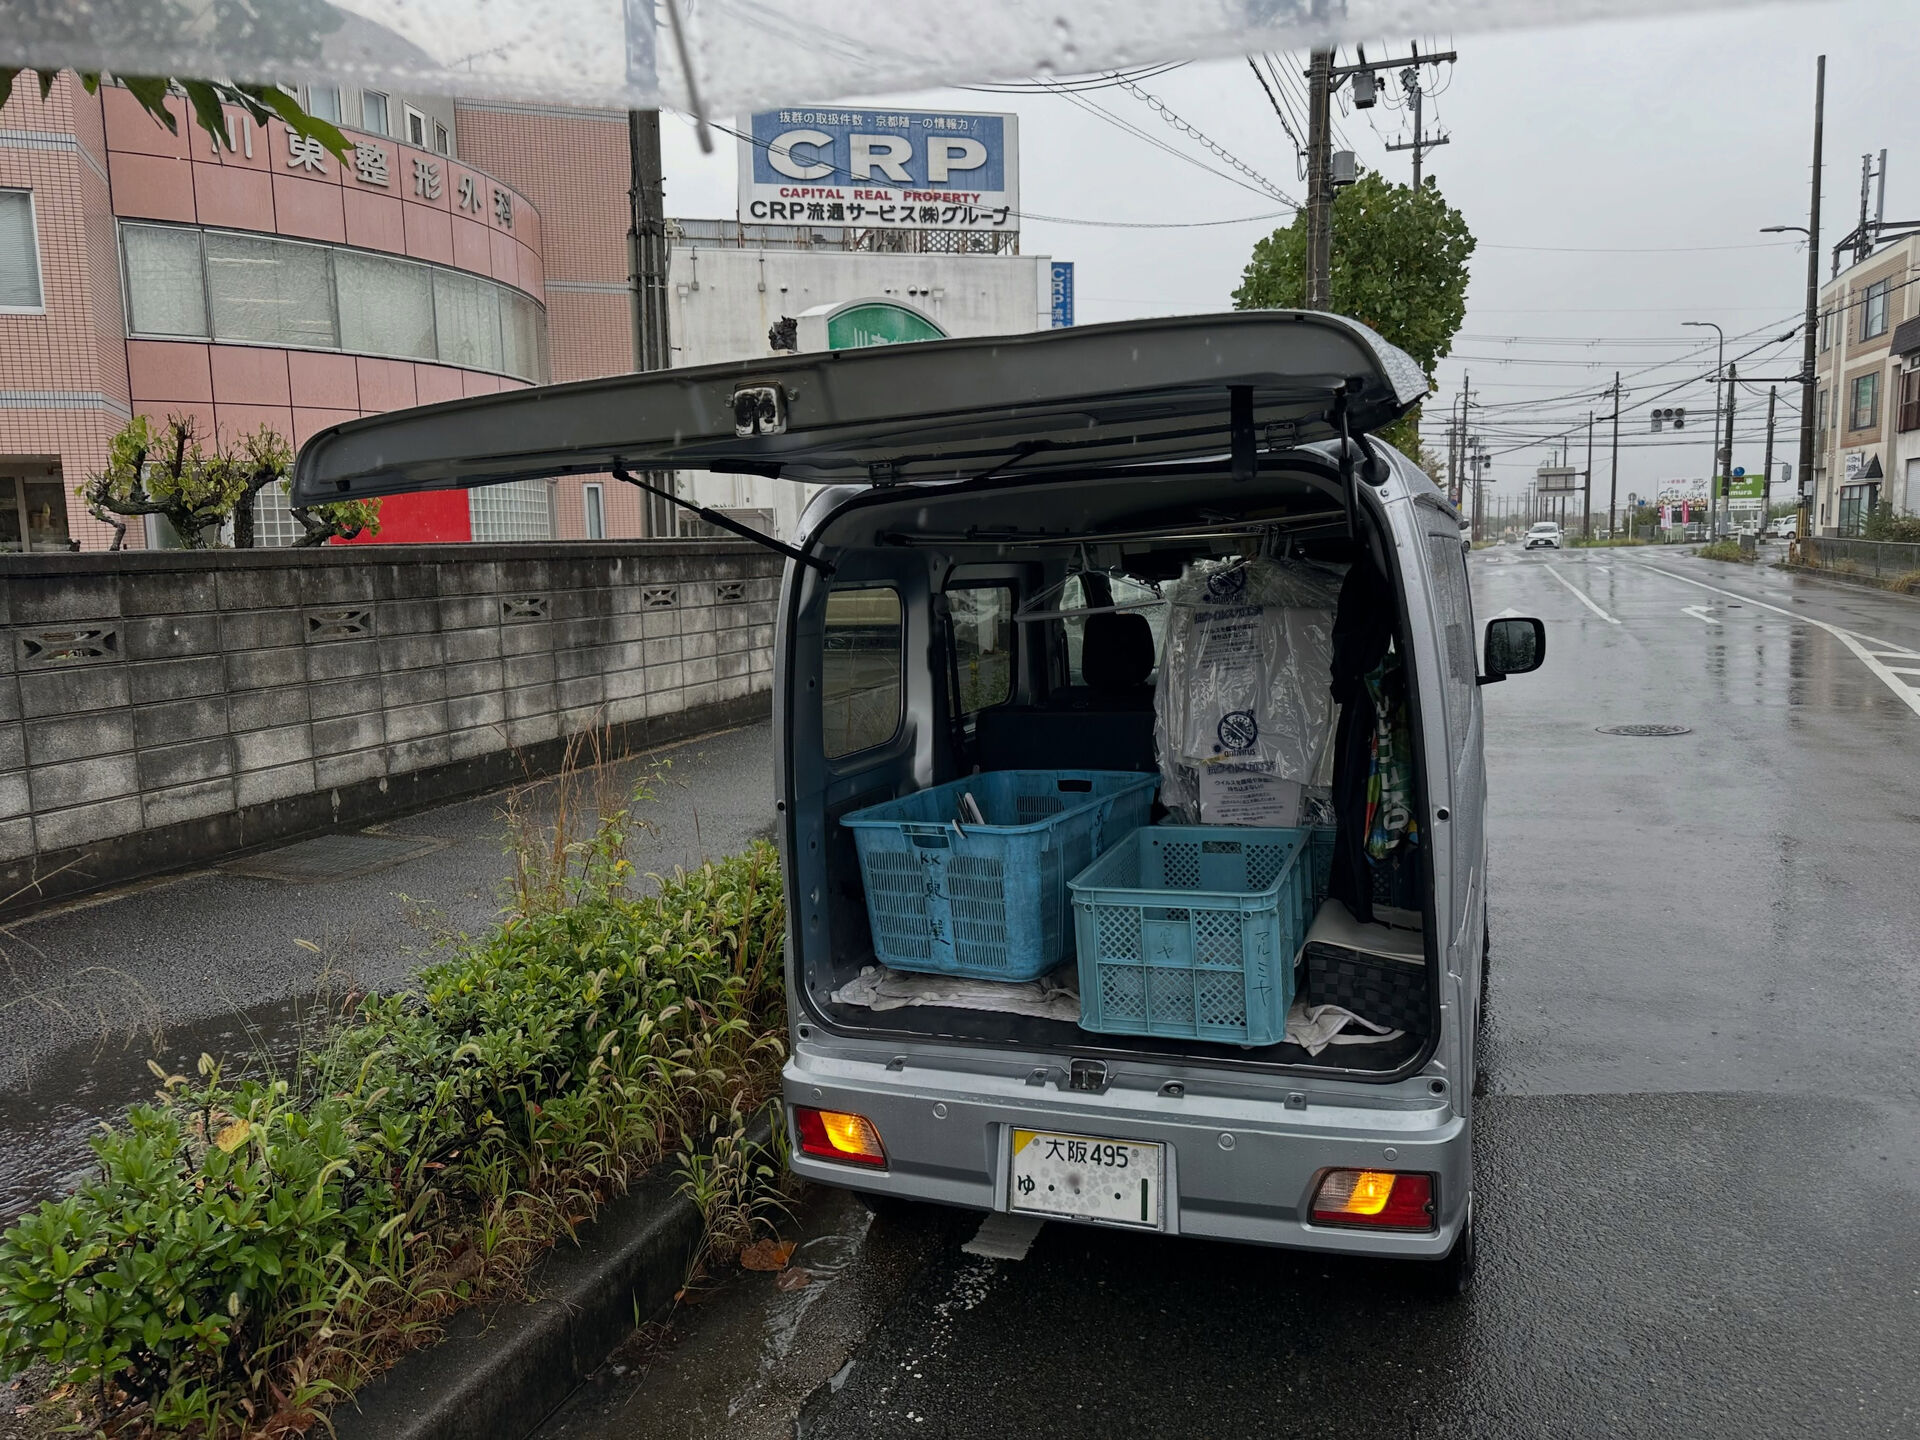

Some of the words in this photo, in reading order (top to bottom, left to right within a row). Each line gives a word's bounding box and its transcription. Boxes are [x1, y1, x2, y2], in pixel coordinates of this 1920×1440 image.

[767, 129, 988, 183] CRP
[780, 187, 845, 200] CAPITAL
[854, 189, 893, 201] REAL
[903, 191, 981, 204] PROPERTY
[1017, 1174, 1036, 1196] ゆ
